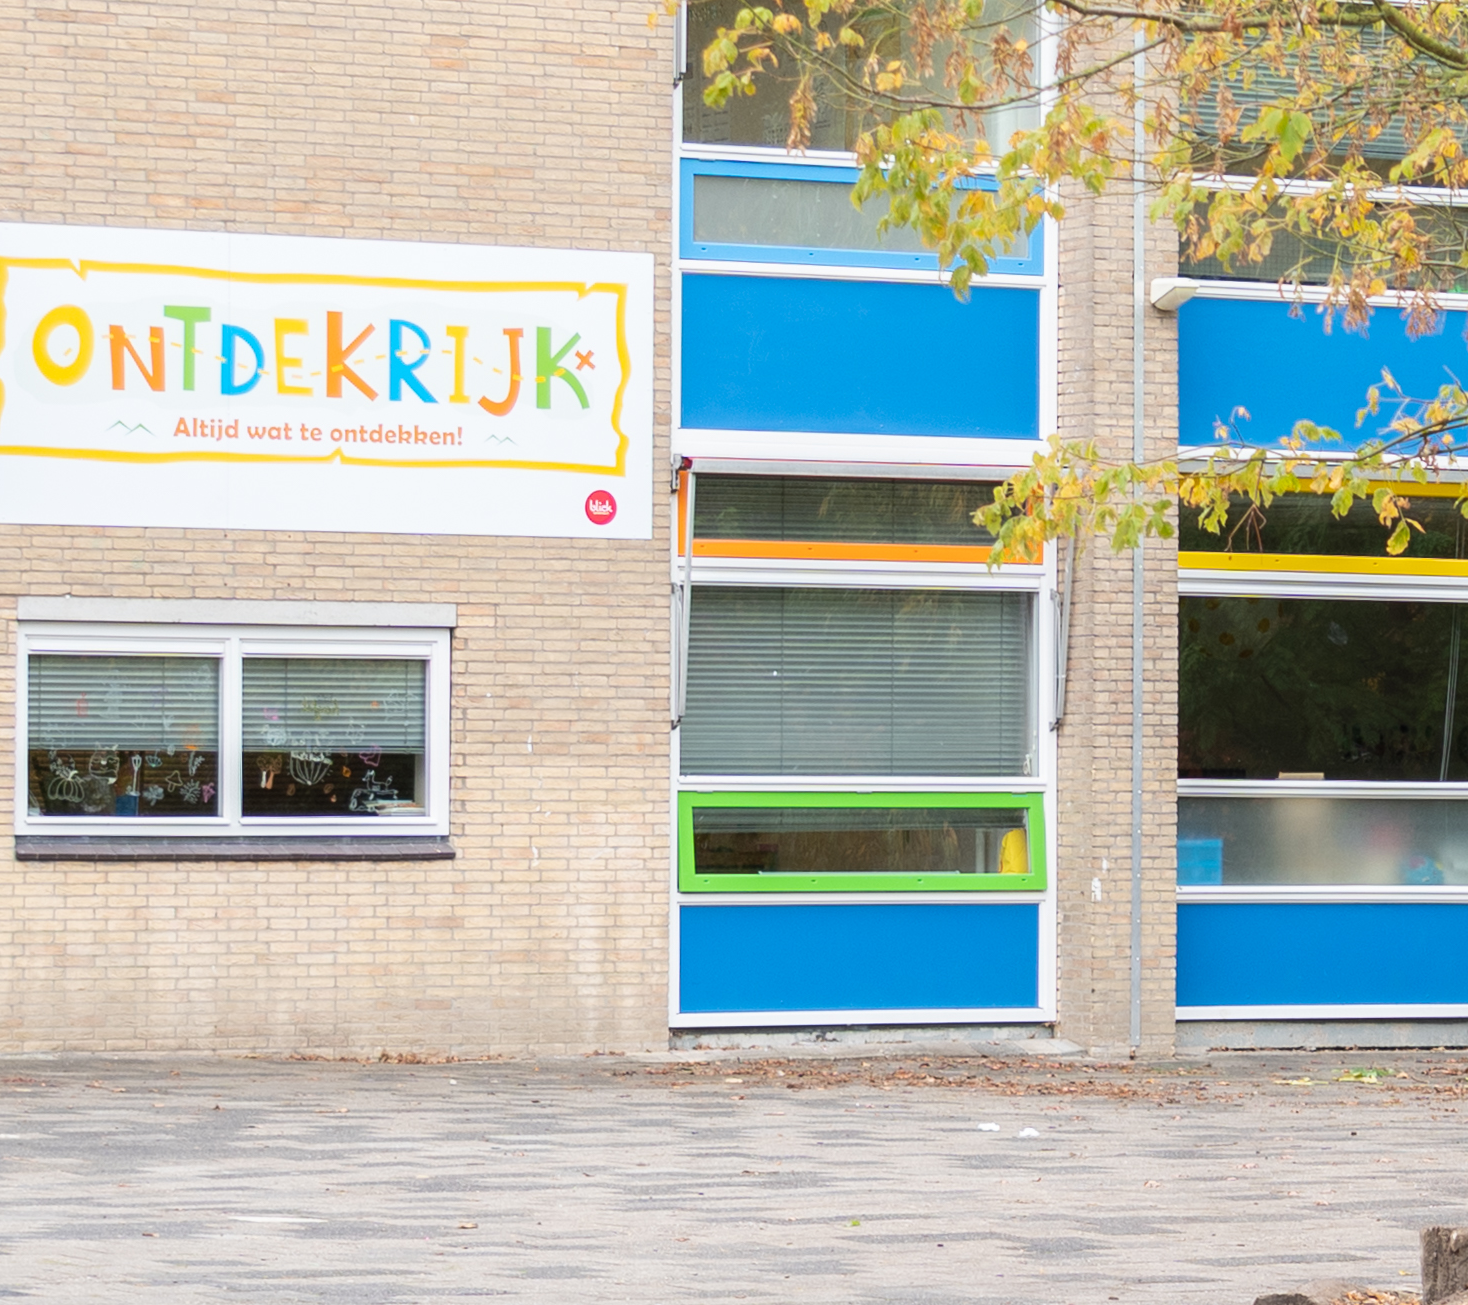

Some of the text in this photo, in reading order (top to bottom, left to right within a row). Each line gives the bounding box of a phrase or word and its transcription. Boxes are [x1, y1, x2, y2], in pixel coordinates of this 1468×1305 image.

[32, 304, 591, 416] ONTDEKRIJK
[173, 417, 464, 446] Altijd wat te ontdekken!
